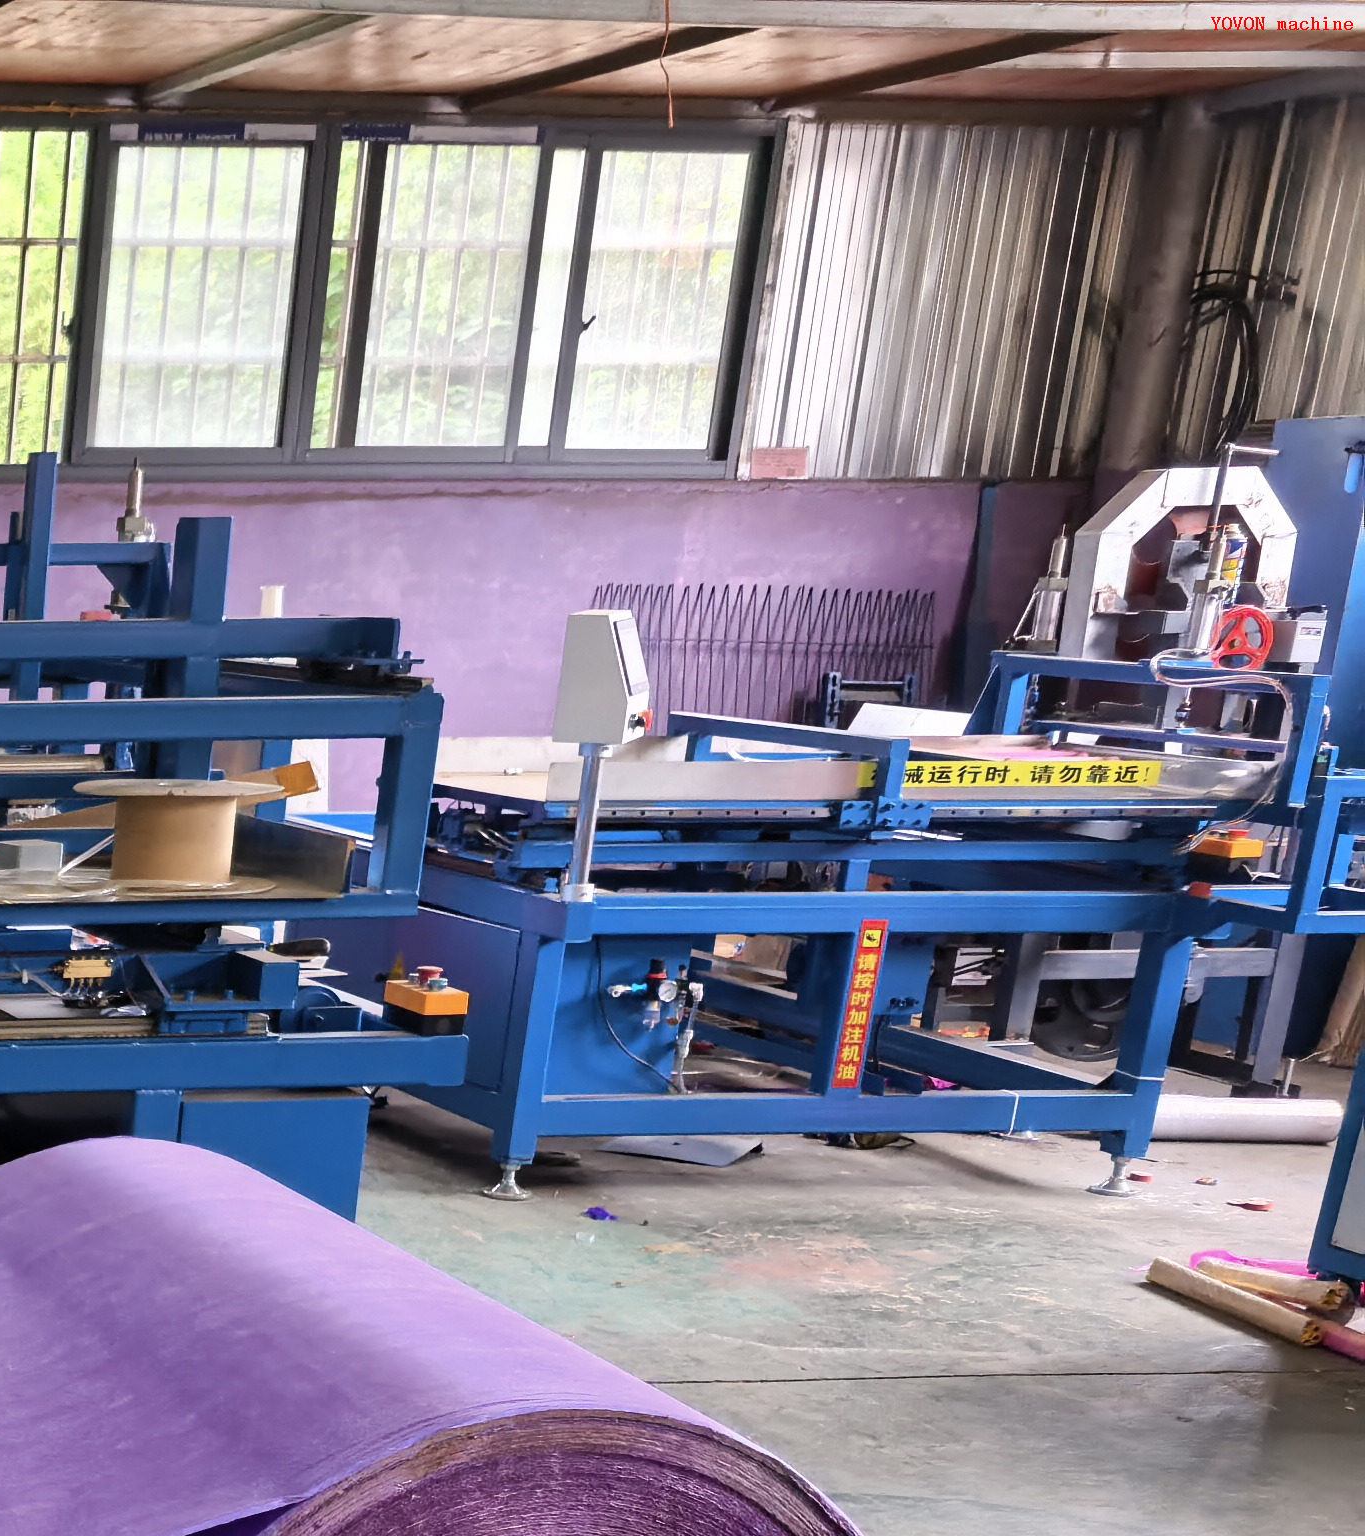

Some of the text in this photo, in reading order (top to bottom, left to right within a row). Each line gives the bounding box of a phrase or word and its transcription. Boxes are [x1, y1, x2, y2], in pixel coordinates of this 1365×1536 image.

[837, 954, 878, 1080] 请按时加注机油
